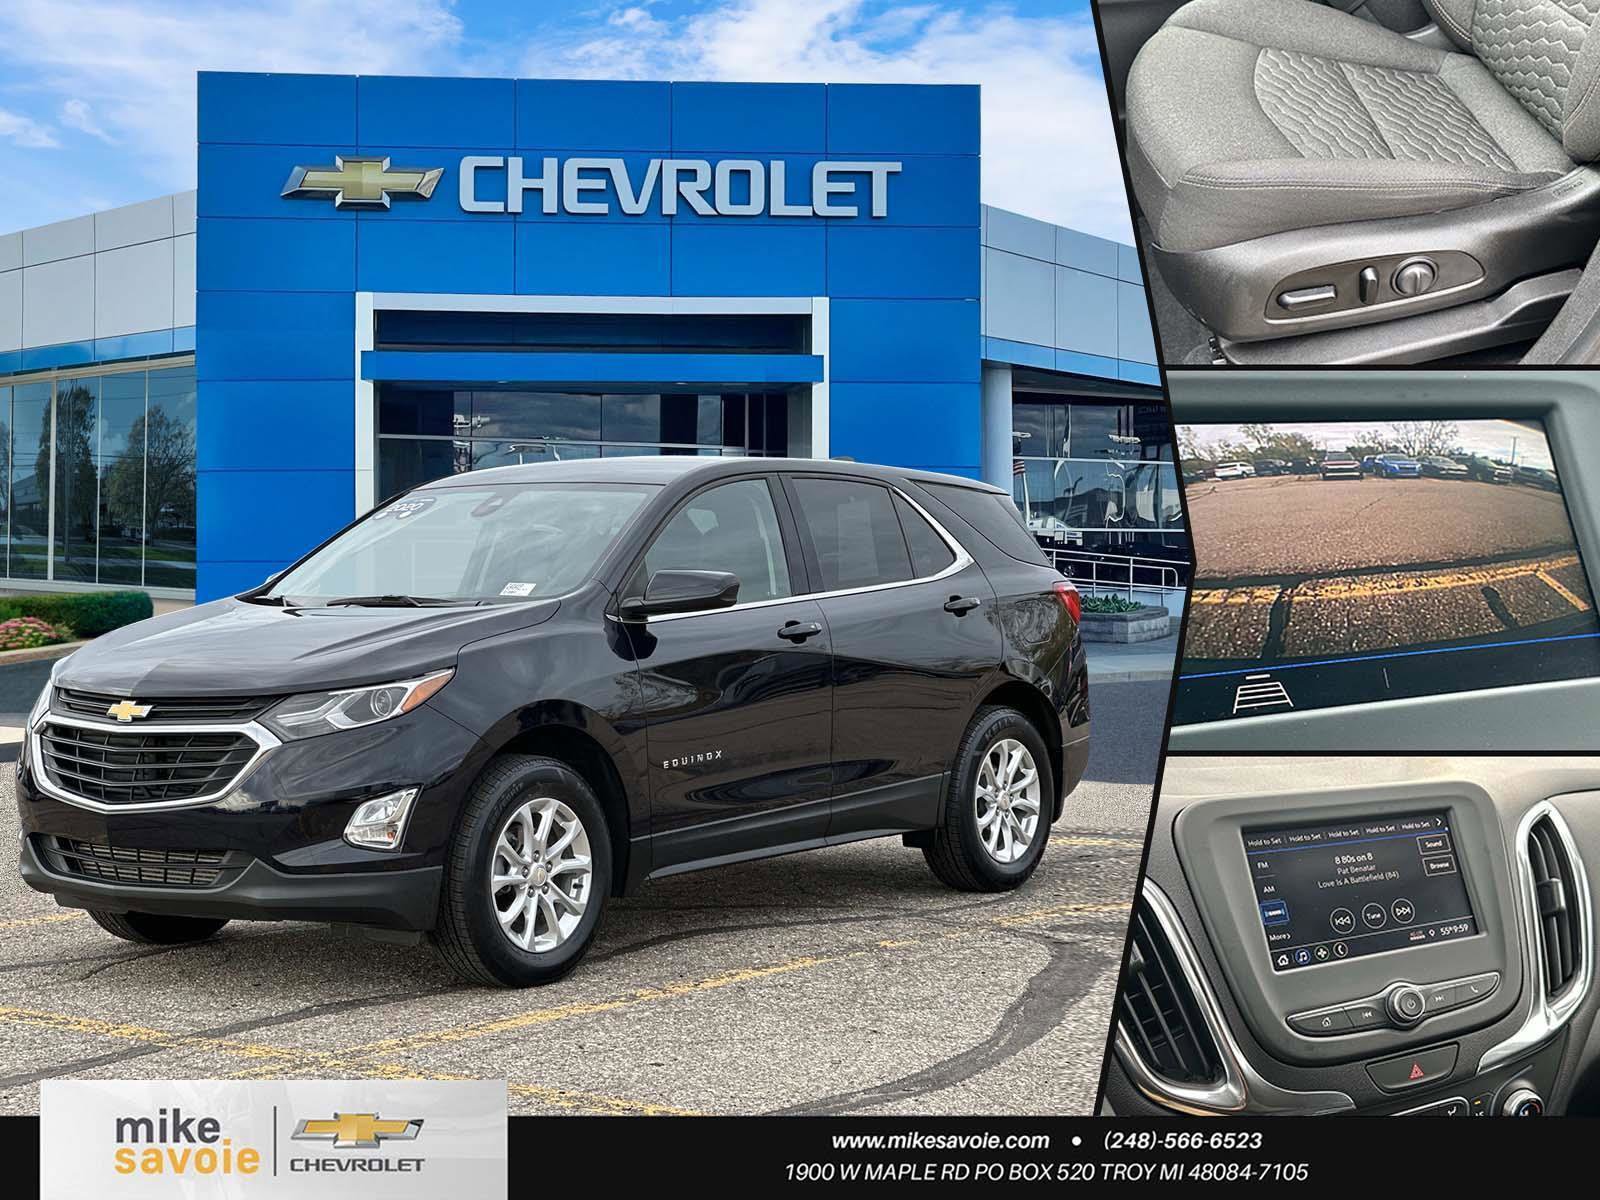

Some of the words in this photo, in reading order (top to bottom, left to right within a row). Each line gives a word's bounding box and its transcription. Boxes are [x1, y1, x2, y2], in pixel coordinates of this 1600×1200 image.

[459, 156, 902, 218] CHEVROLET
[662, 749, 723, 769] EQUINOX
[1247, 839, 1263, 847] Hold
[1425, 840, 1443, 848] Sound
[1334, 856, 1341, 865] 8
[1341, 855, 1356, 863] 80s
[1366, 852, 1374, 861] 8
[1257, 861, 1270, 869] FM
[1337, 866, 1350, 875] Pat
[1351, 864, 1377, 874] Benatar
[1429, 861, 1450, 870] Browse
[1318, 881, 1335, 889] Love
[1350, 872, 1384, 885] Battlefield
[1263, 884, 1276, 894] AM
[1269, 933, 1287, 942] More
